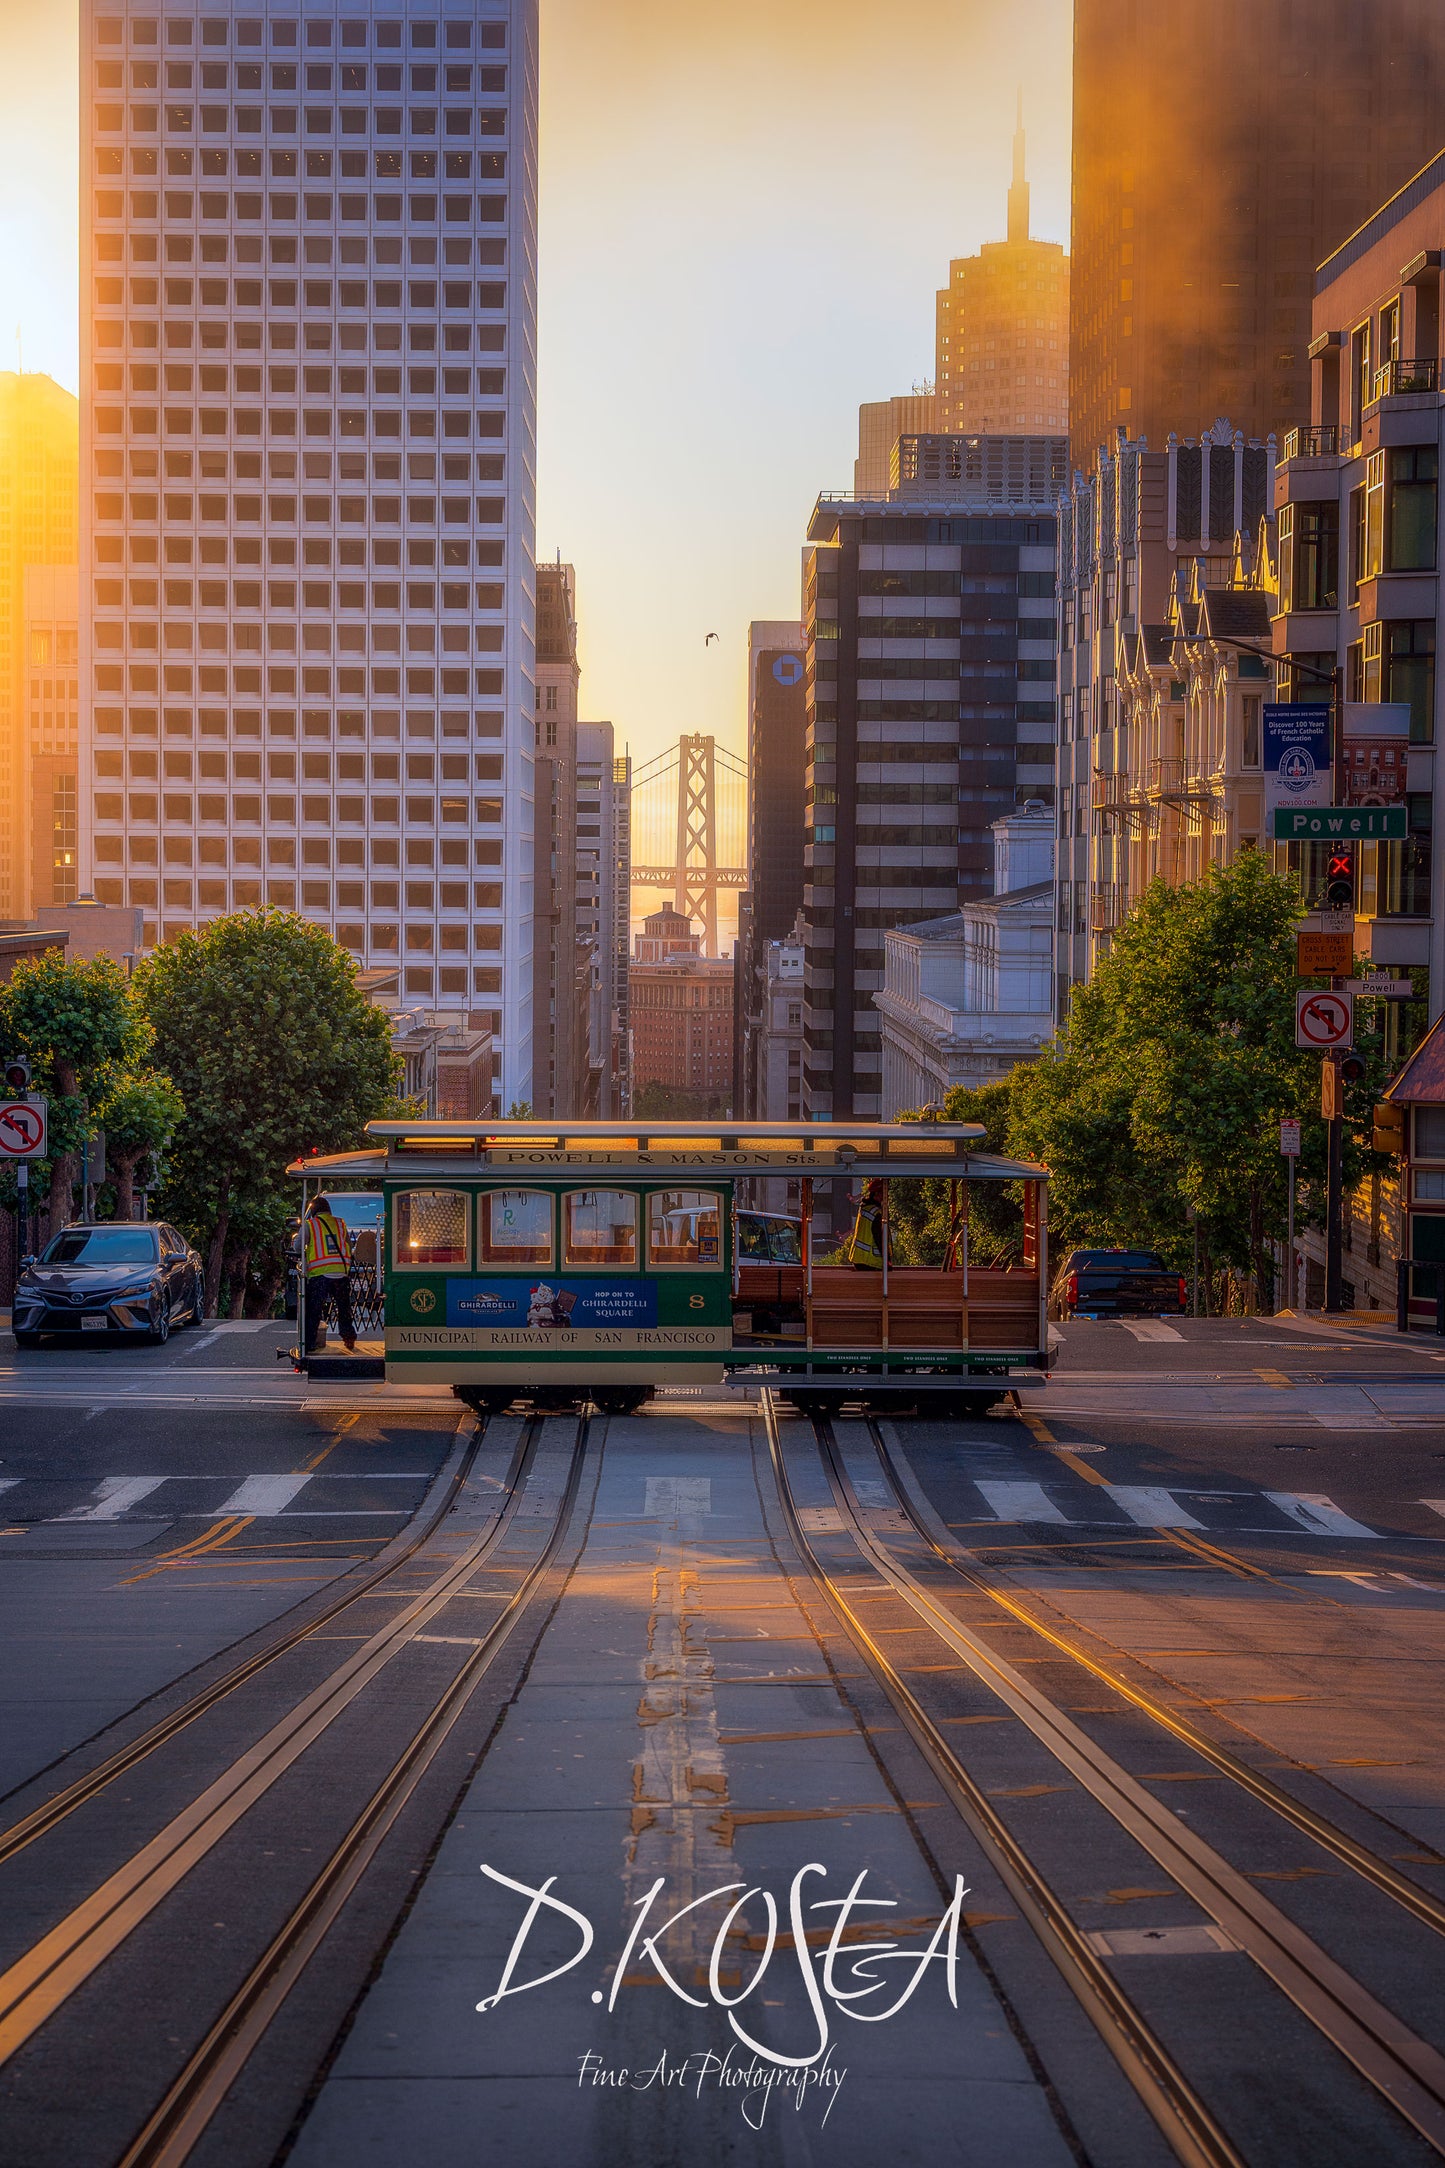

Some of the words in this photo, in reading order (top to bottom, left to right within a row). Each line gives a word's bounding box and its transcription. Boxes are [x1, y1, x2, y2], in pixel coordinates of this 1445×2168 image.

[1293, 815, 1388, 832] Powell
[1362, 984, 1395, 992] Powell
[507, 1153, 622, 1163] POWELL
[637, 1153, 655, 1164] &
[671, 1154, 770, 1164] MASON
[786, 1154, 821, 1164] Sts.
[582, 1300, 647, 1308] GHIRARDELLI
[689, 1294, 705, 1309] 8
[595, 1309, 634, 1318] SQUARE
[400, 1332, 477, 1343] MUNICIPAL
[491, 1332, 552, 1343] RAILWAY
[561, 1332, 578, 1343] OF
[595, 1332, 622, 1343] SAN
[637, 1332, 715, 1343] FRANCISCO
